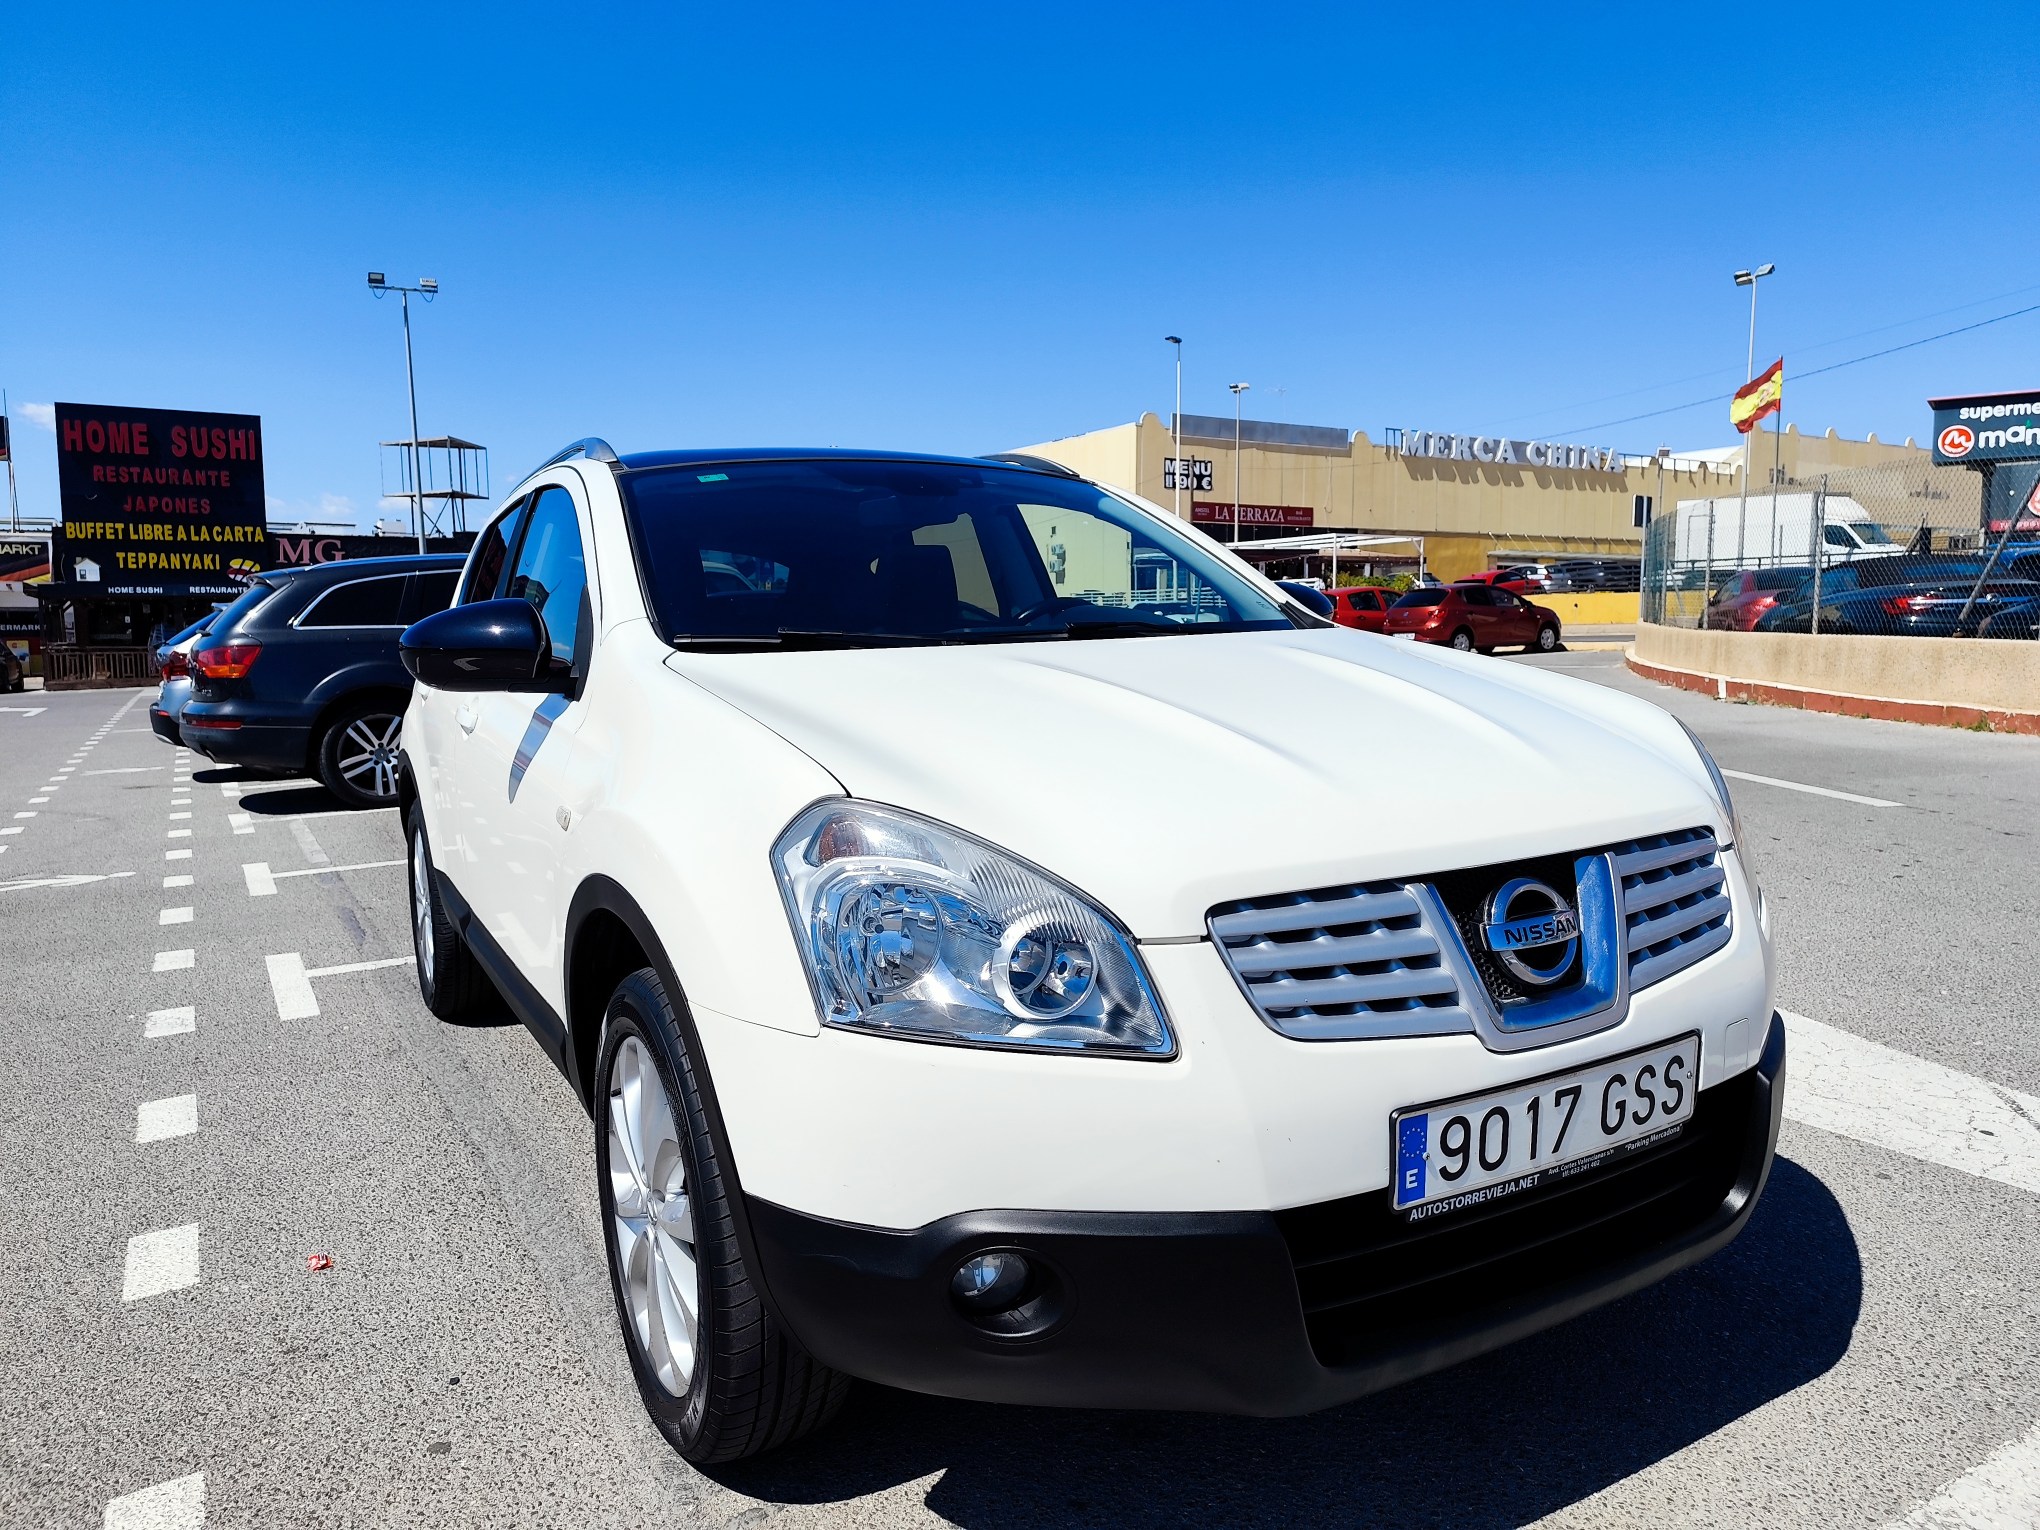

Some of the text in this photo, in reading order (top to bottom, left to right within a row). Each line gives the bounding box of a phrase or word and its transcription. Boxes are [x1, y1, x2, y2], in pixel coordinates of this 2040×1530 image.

[1960, 402, 2040, 422] superme
[63, 419, 256, 461] HOME SUSHI
[1400, 429, 1625, 473] MERCA CHINA
[93, 465, 231, 487] RESTAURANTE
[1201, 476, 1212, 490] €
[123, 496, 211, 515] JAPONES
[1214, 506, 1285, 522] LA TERRAZA
[65, 522, 264, 543] BUFFET LIBRE A LA CARTA
[0, 543, 41, 555] ARKT
[275, 537, 346, 564] MG
[116, 552, 221, 570] TEPPANYAKI
[108, 586, 134, 594] HOME
[136, 586, 163, 594] SUSHI
[1503, 916, 1577, 945] NISSAN
[1405, 1055, 1685, 1190] E 9017 GSS
[1560, 1161, 1577, 1171] Cortes
[1409, 1173, 1540, 1222] AUTOSTORREVIEJA.NET
